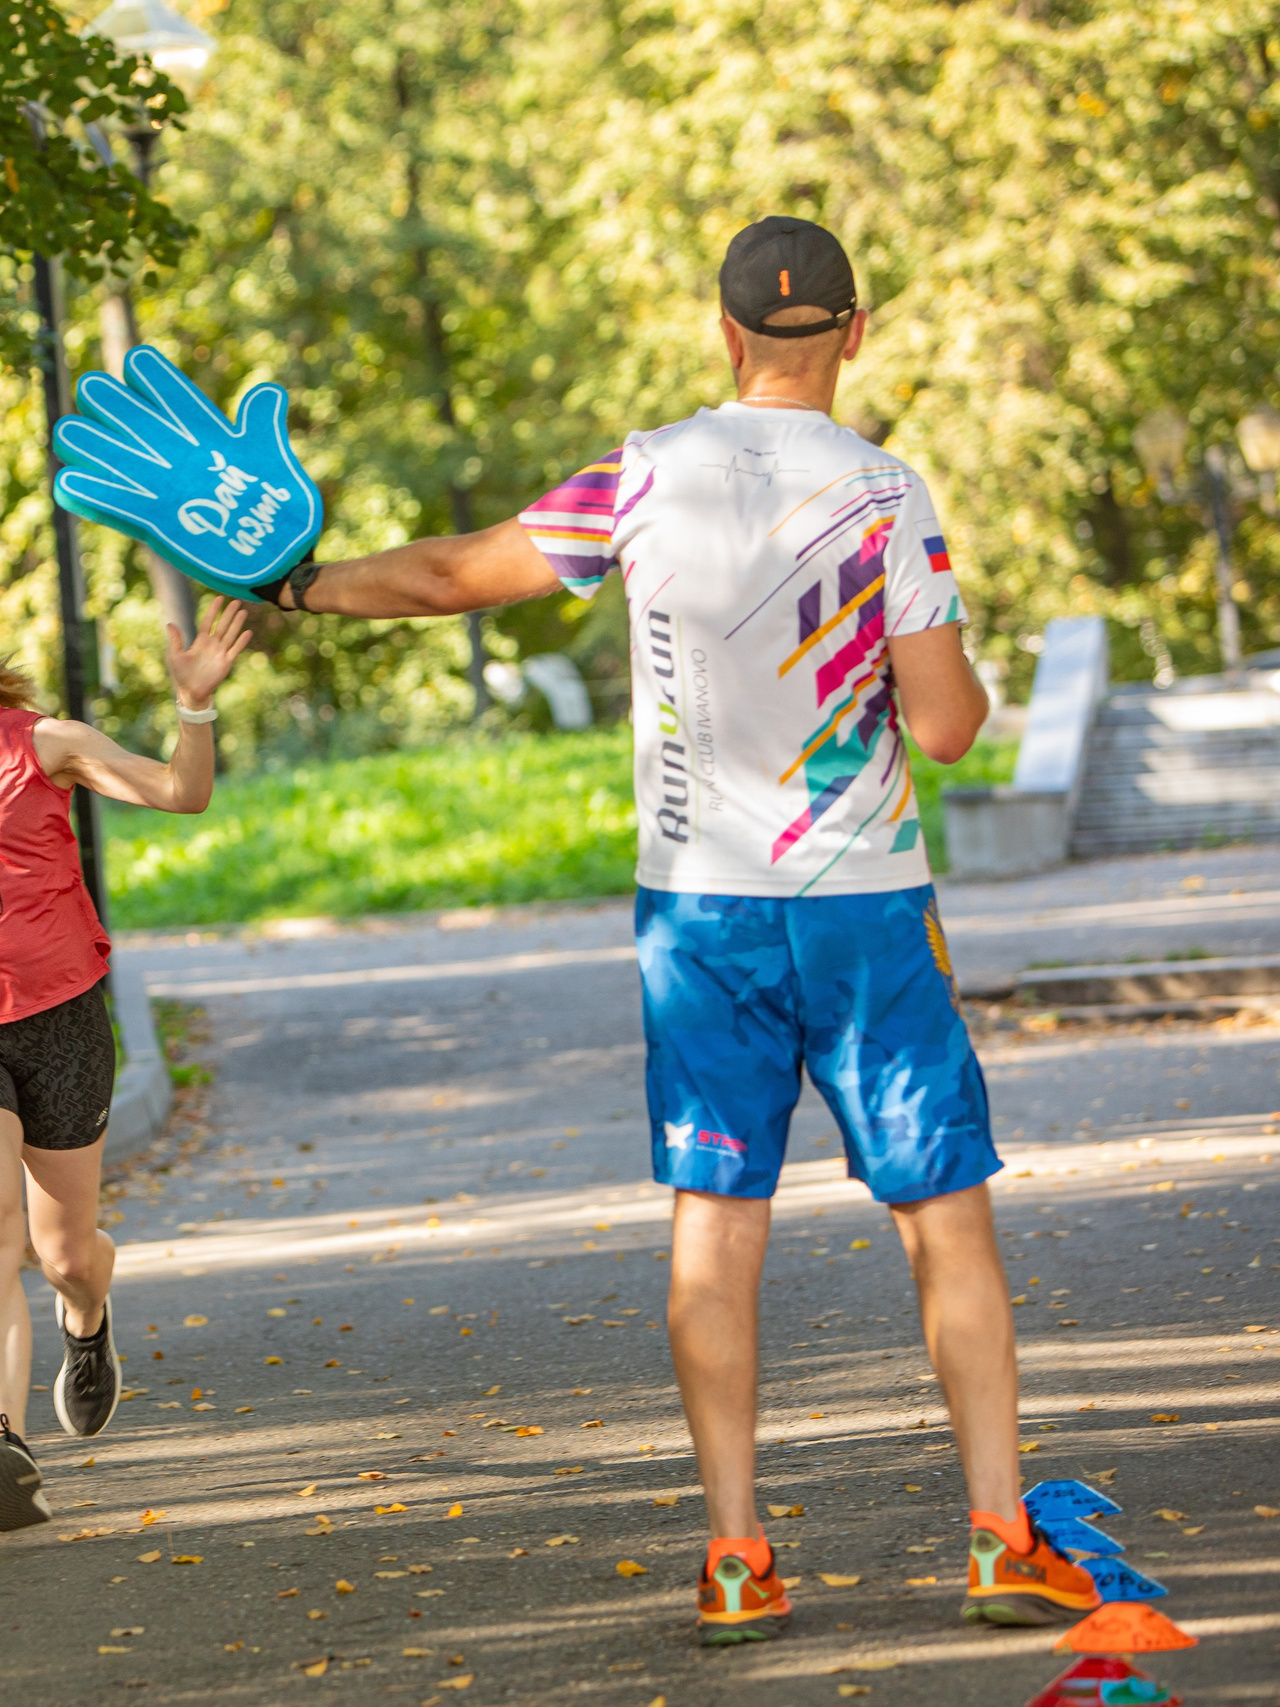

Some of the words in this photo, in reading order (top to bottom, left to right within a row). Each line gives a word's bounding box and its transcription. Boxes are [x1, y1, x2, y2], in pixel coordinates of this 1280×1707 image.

[177, 450, 259, 537] Дай
[691, 648, 714, 730] IVANOVO
[696, 732, 715, 776] CLUB
